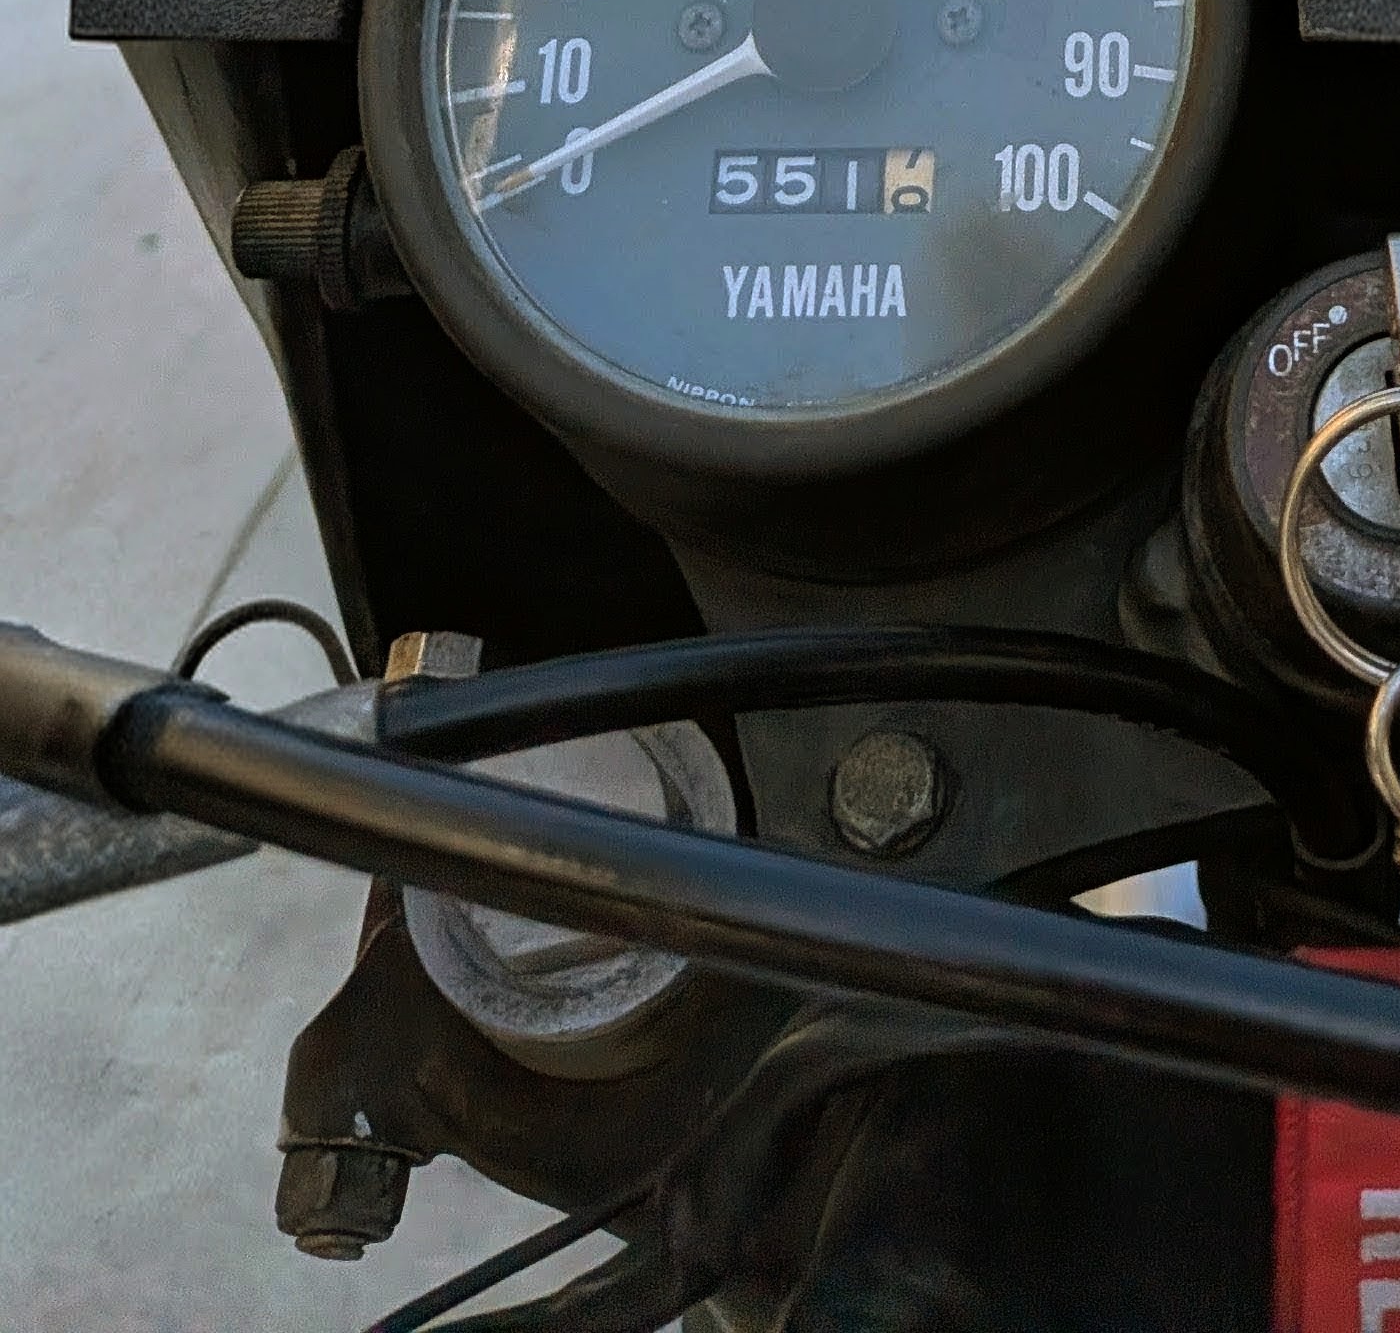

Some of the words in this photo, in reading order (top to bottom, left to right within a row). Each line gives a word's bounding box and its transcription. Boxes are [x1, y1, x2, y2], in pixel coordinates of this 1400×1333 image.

[538, 37, 592, 105] 10
[1064, 32, 1130, 99] 90
[561, 126, 594, 195] 0
[994, 142, 1079, 212] 100
[723, 264, 908, 320] YAMAHA
[1268, 322, 1331, 377] OFF
